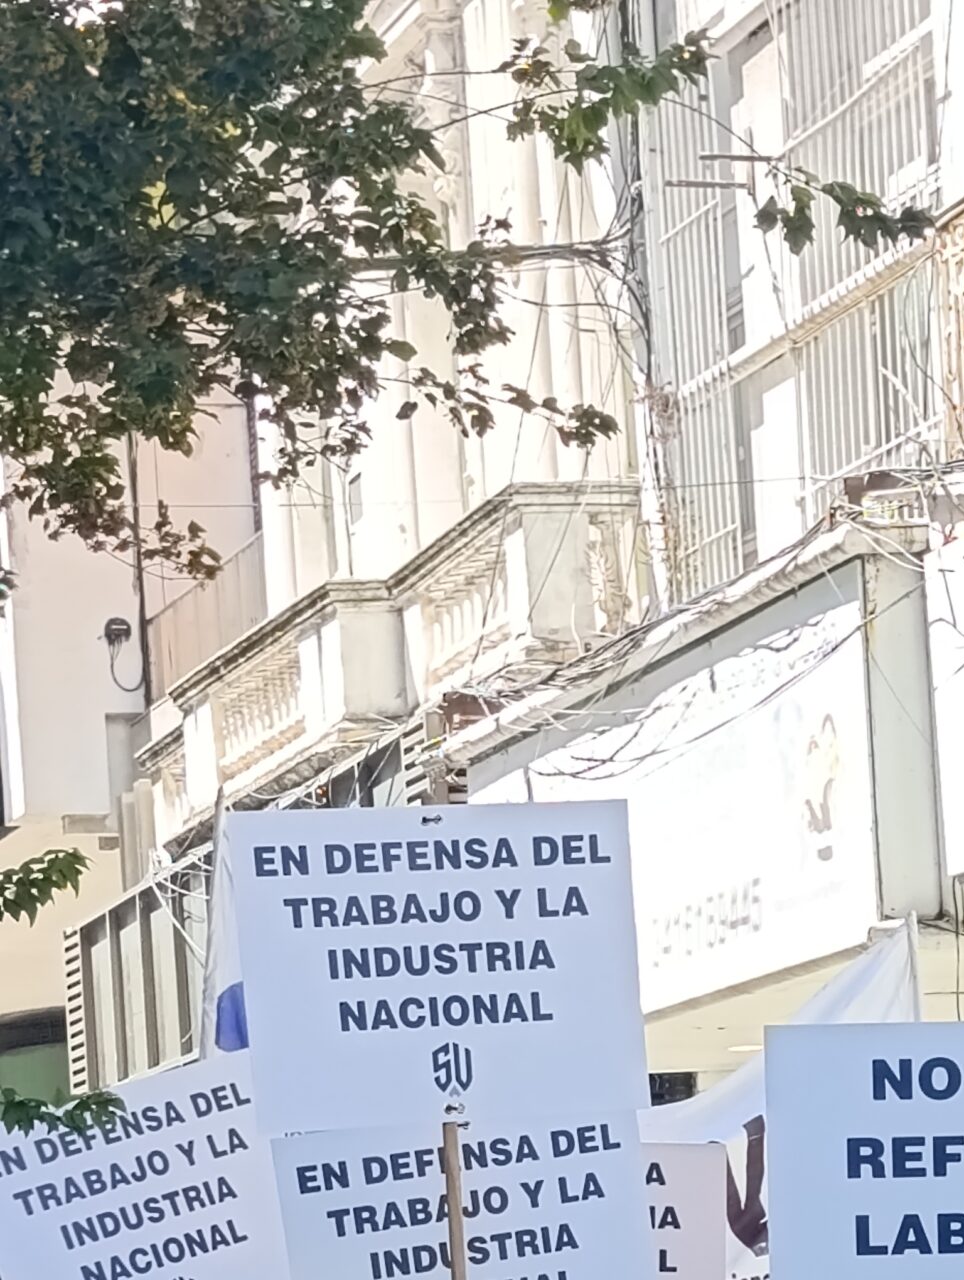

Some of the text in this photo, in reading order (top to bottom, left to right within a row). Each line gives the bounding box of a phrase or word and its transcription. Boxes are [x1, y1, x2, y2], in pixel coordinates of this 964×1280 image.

[253, 834, 611, 877] EN DEFENSA DEL
[283, 886, 588, 929] TRABAJO Y LA
[327, 939, 555, 980] INDUSTRIA
[339, 991, 553, 1032] NACIONAL
[872, 1057, 961, 1100] NO
[0, 1146, 27, 1178] N
[189, 1083, 251, 1118] DEL
[13, 1128, 248, 1215] TRABAJO Y LA
[296, 1161, 349, 1194] EN
[551, 1123, 621, 1157] DEL
[520, 1180, 546, 1208] Y
[558, 1172, 605, 1203] LA
[60, 1176, 238, 1250] INDUSTRIA
